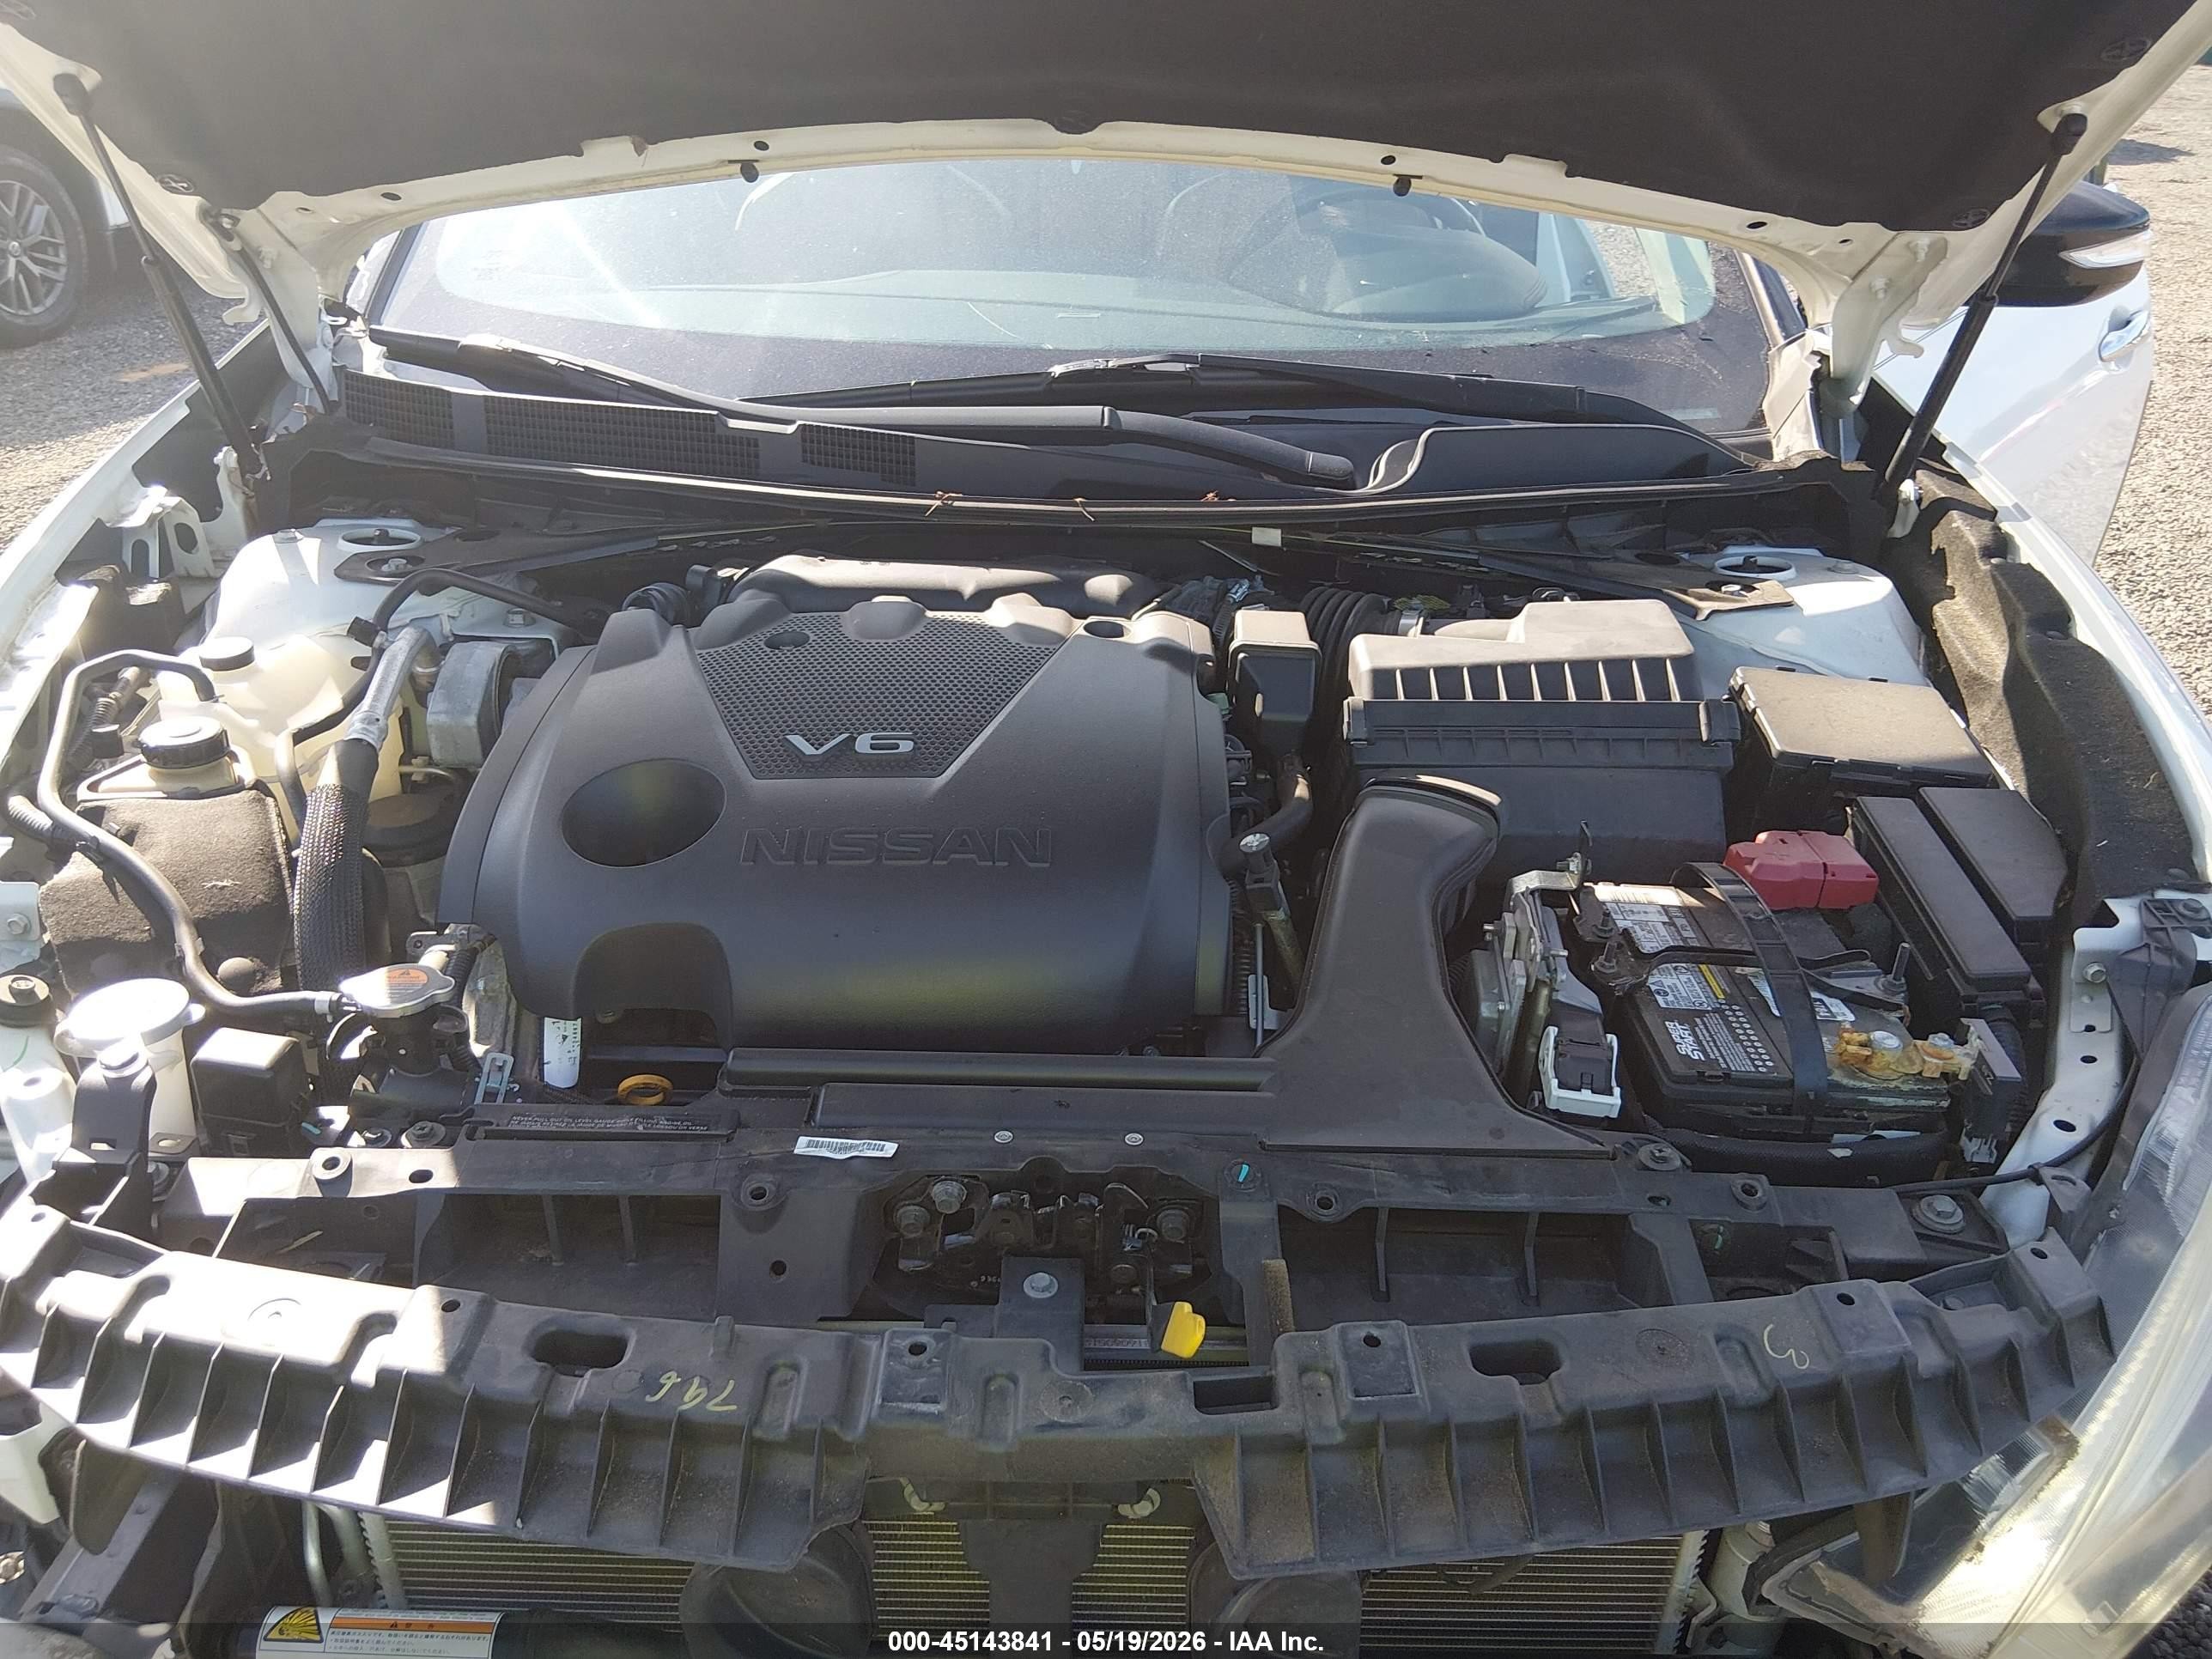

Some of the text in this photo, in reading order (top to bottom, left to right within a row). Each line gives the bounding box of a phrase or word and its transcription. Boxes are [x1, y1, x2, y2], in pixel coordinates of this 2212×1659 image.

[783, 731, 915, 757] V6
[740, 827, 1052, 867] NISSAN
[1664, 1021, 1687, 1055] SUPER
[645, 1370, 738, 1412] 796
